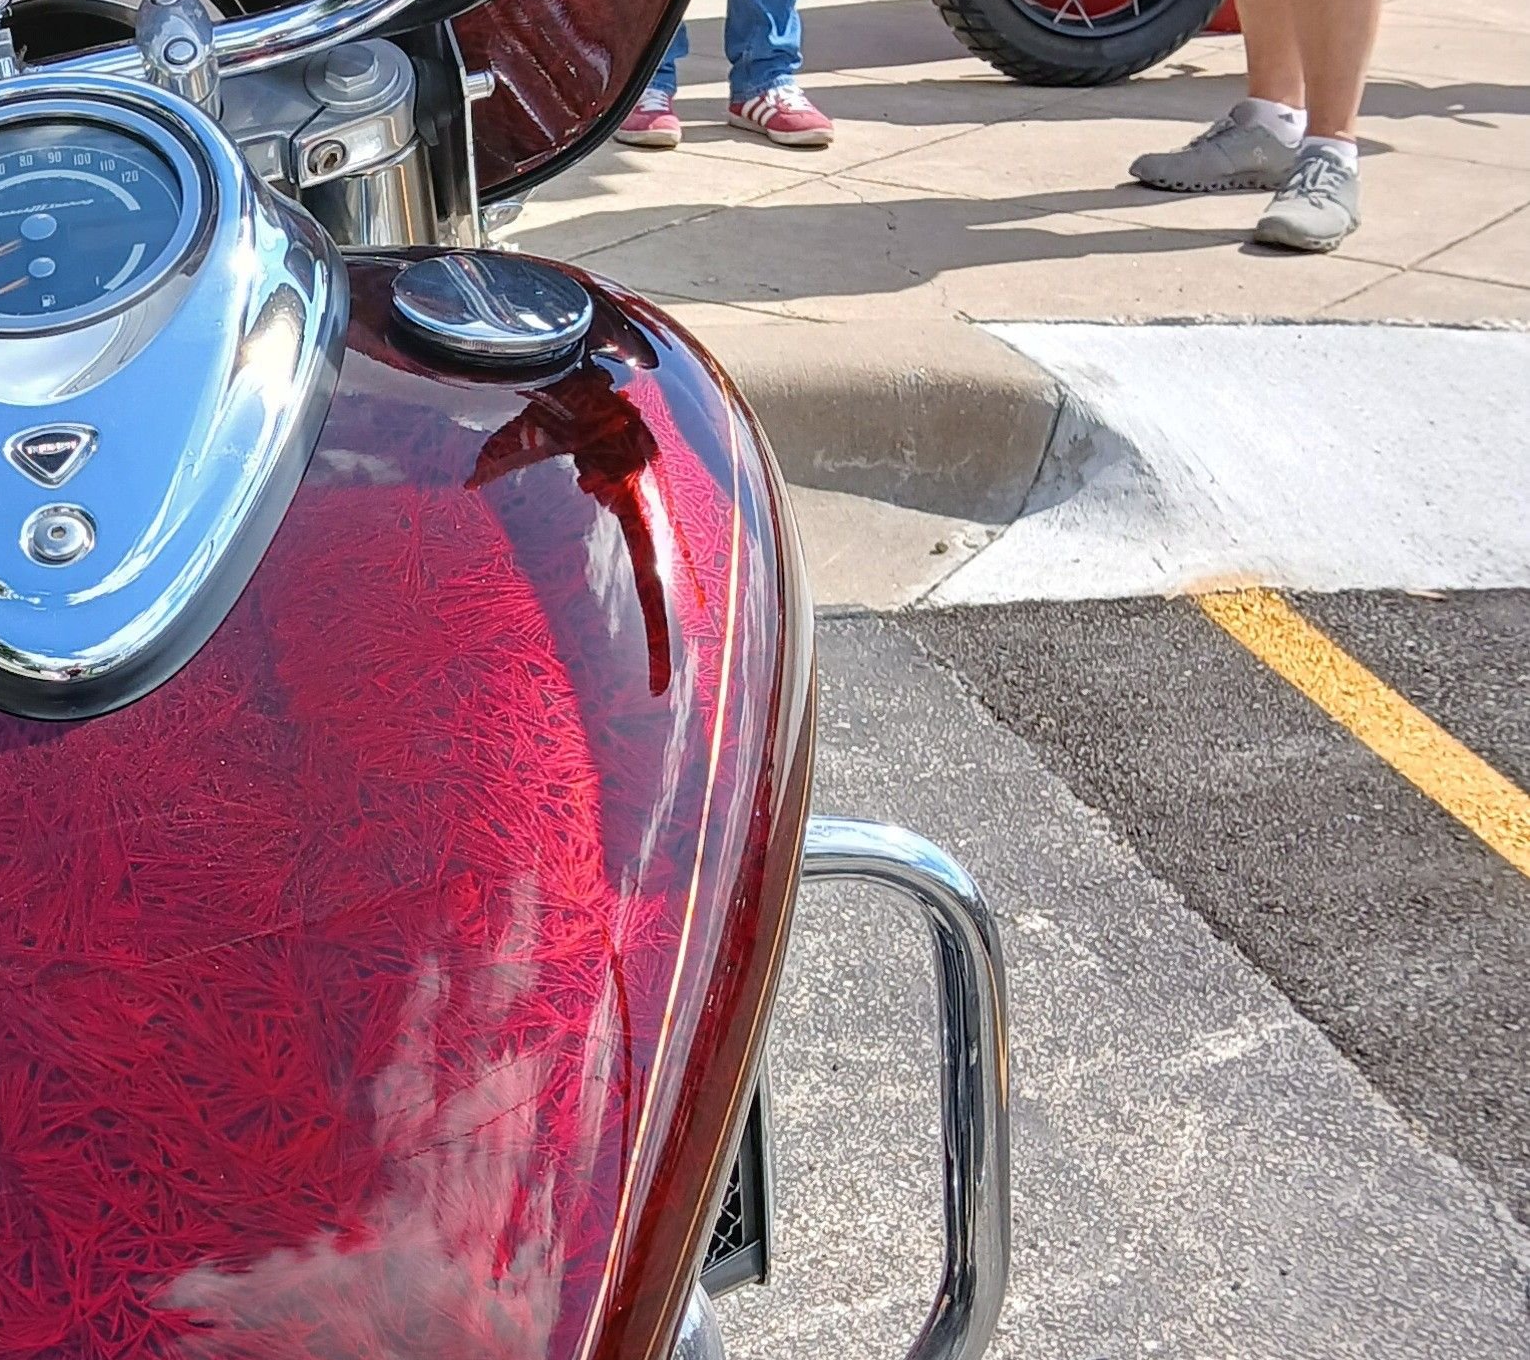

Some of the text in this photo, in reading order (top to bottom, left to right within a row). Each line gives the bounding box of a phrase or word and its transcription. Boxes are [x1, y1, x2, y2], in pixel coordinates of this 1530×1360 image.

[20, 155, 33, 167] 80
[48, 151, 62, 163] 90
[73, 153, 91, 165] 100
[100, 159, 115, 171] 110
[121, 170, 139, 183] 120
